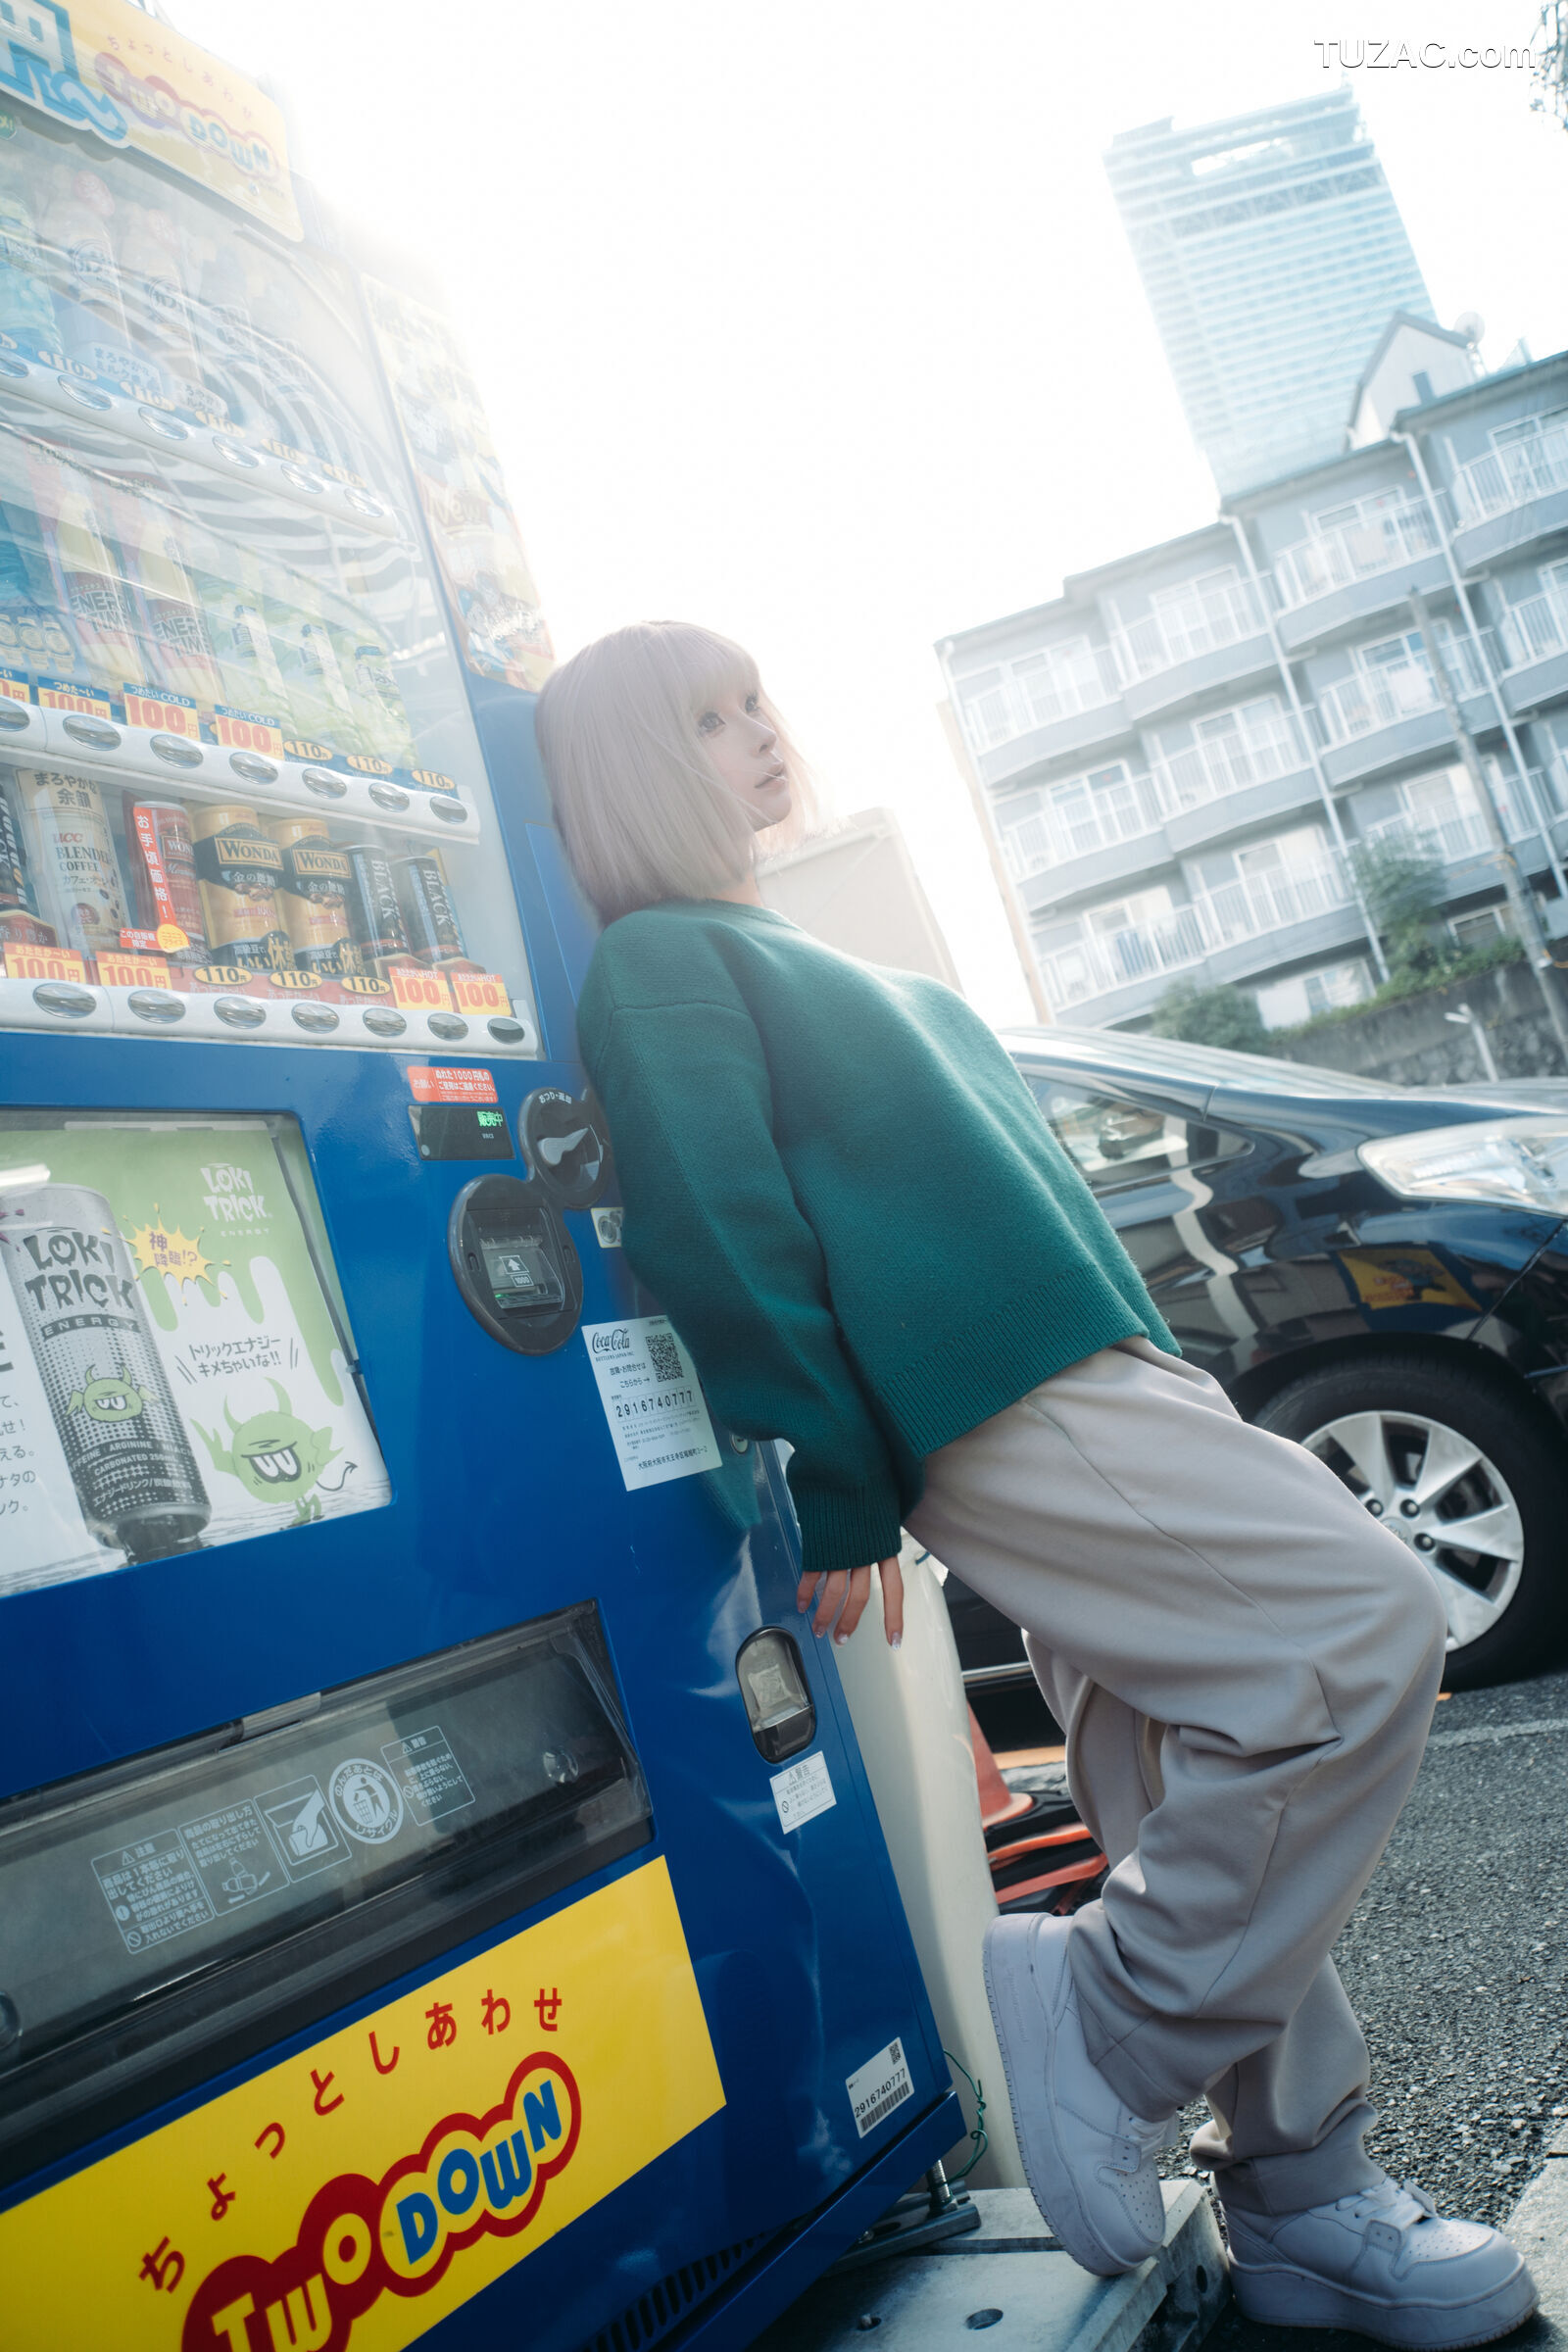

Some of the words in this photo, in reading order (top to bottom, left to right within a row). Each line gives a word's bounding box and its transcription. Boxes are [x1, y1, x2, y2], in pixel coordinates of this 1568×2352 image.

[187, 113, 272, 172] DOWN
[160, 693, 190, 708] COLD
[125, 692, 199, 738] 100円
[248, 713, 275, 727] COLD
[216, 713, 283, 757] 100円
[52, 832, 83, 844] UCC
[219, 839, 280, 862] WONDA
[298, 851, 349, 871] WONDA
[371, 859, 396, 919] BLACK
[422, 869, 451, 926] BLACK
[11, 956, 80, 983] 100円
[103, 965, 166, 988] 100円
[203, 966, 248, 983] 110円
[278, 971, 318, 987] 110円
[422, 969, 439, 980] HOT
[349, 977, 386, 994] 110円
[392, 977, 451, 1006] 100円
[454, 981, 509, 1008] 100円
[477, 1110, 504, 1127] 販売中
[200, 1165, 255, 1195] LOKI
[203, 1194, 268, 1223] TRICK
[149, 1231, 168, 1251] 神
[220, 1228, 270, 1238] ENERGY
[23, 1231, 116, 1273] LOKI
[24, 1269, 134, 1311] TRICK
[43, 1316, 140, 1339] ENERGY
[188, 1335, 282, 1361] トリックエナジー
[615, 1390, 694, 1419] 2916740777
[109, 1440, 154, 1452] ARGININE
[94, 1453, 149, 1476] CARBONATED
[334, 1763, 386, 1797] のんだあとは
[356, 1808, 398, 1838] リサイクル
[107, 1866, 173, 1901] 出してください
[855, 2068, 906, 2118] 2916740777
[138, 1987, 564, 2294] ちょっとしあわせ
[211, 2212, 372, 2352] TWO
[395, 2080, 563, 2266] DOWN
